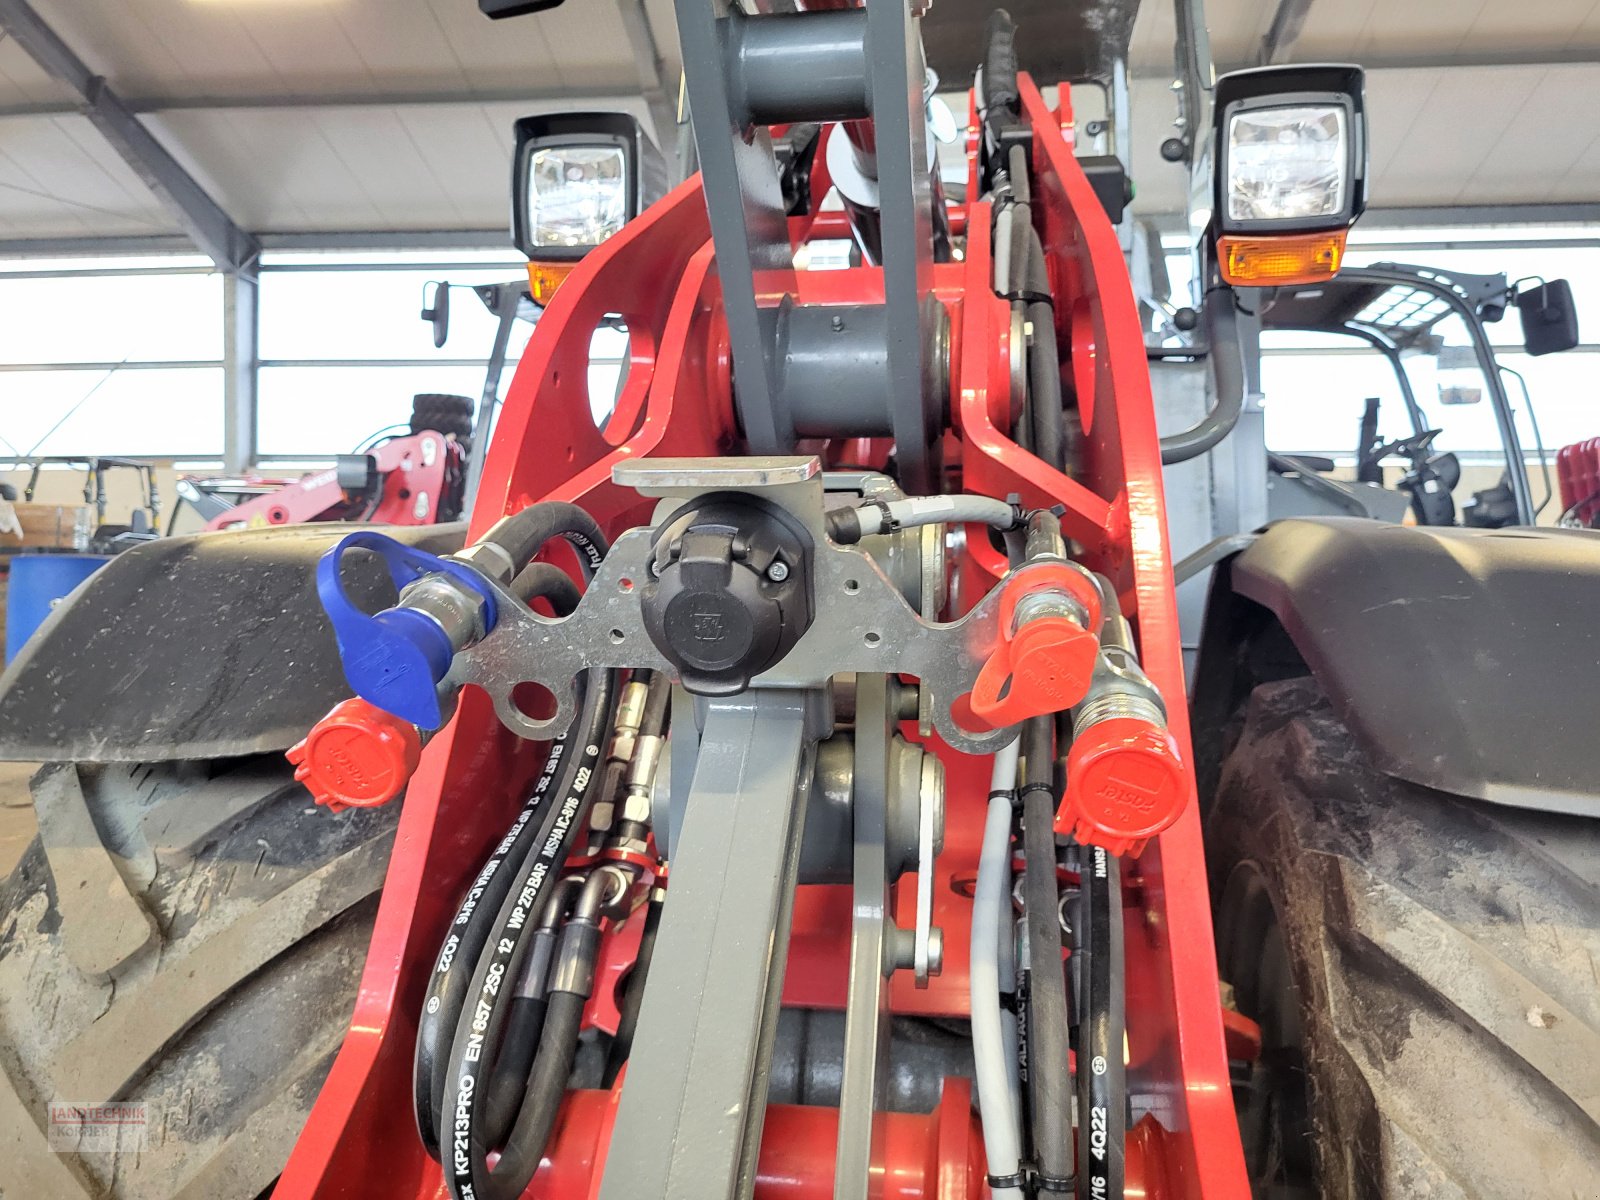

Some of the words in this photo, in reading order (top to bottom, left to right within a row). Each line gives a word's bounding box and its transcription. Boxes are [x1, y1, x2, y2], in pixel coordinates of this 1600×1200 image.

[573, 766, 592, 793] 4Q22
[1096, 785, 1156, 815] Faster
[496, 835, 517, 855] BAR
[541, 828, 565, 858] MSHA
[526, 862, 549, 889] BAR
[518, 886, 537, 909] 275
[507, 907, 526, 929] WP
[437, 934, 459, 973] 4Q22
[497, 938, 515, 954] 12
[483, 963, 505, 996] 2SC
[472, 1000, 492, 1031] 857
[465, 1033, 484, 1062] EN
[454, 1074, 475, 1176] KP213PRO
[1091, 1106, 1107, 1161] 4Q22
